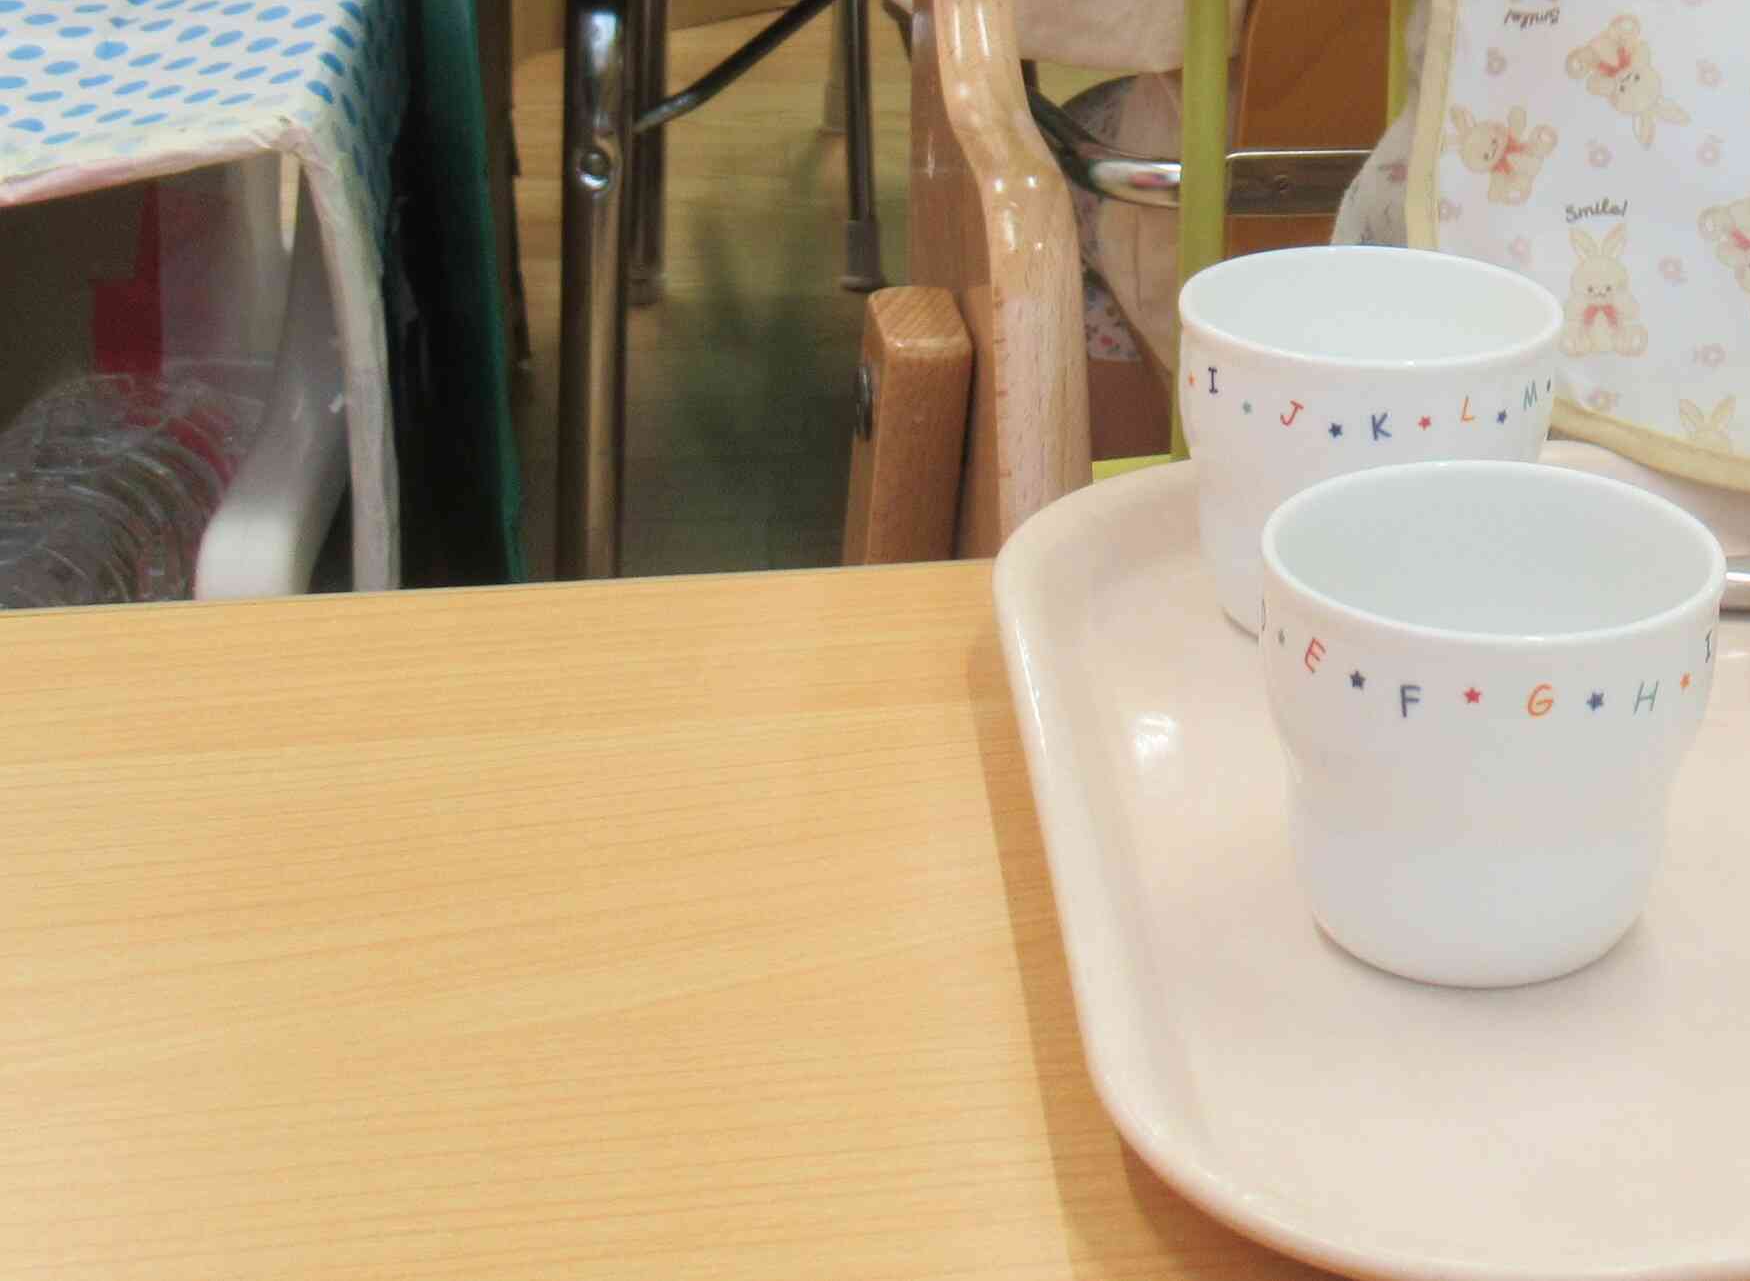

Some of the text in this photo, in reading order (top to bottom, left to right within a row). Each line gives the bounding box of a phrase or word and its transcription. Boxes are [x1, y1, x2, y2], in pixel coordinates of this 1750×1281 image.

[1280, 400, 1304, 426] J
[1371, 412, 1393, 441] K
[1460, 395, 1476, 422] L
[1523, 380, 1538, 411] M
[1305, 636, 1326, 673] E
[1401, 685, 1421, 718] F
[1527, 684, 1554, 717] G
[1633, 680, 1659, 715] H
